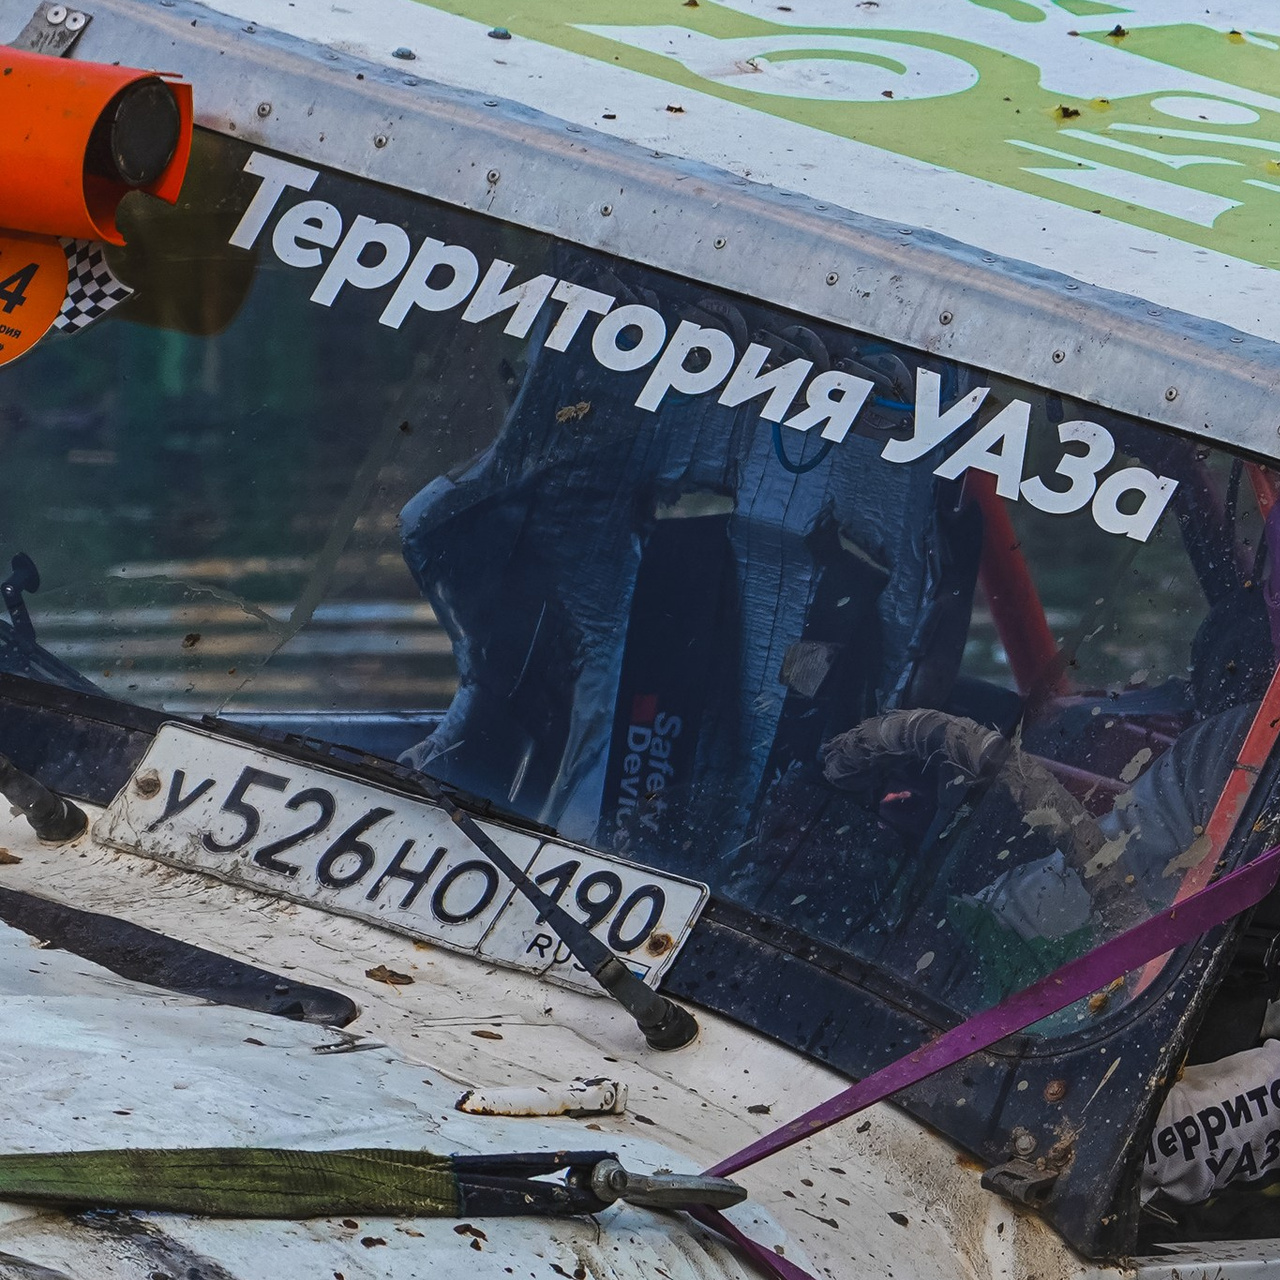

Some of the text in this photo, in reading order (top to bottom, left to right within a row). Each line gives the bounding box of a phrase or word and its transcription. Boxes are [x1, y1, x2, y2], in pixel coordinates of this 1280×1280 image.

[228, 151, 1179, 542] Территория УАЗа
[639, 711, 682, 833] Safety
[526, 933, 586, 973] RU
[535, 860, 666, 952] 190
